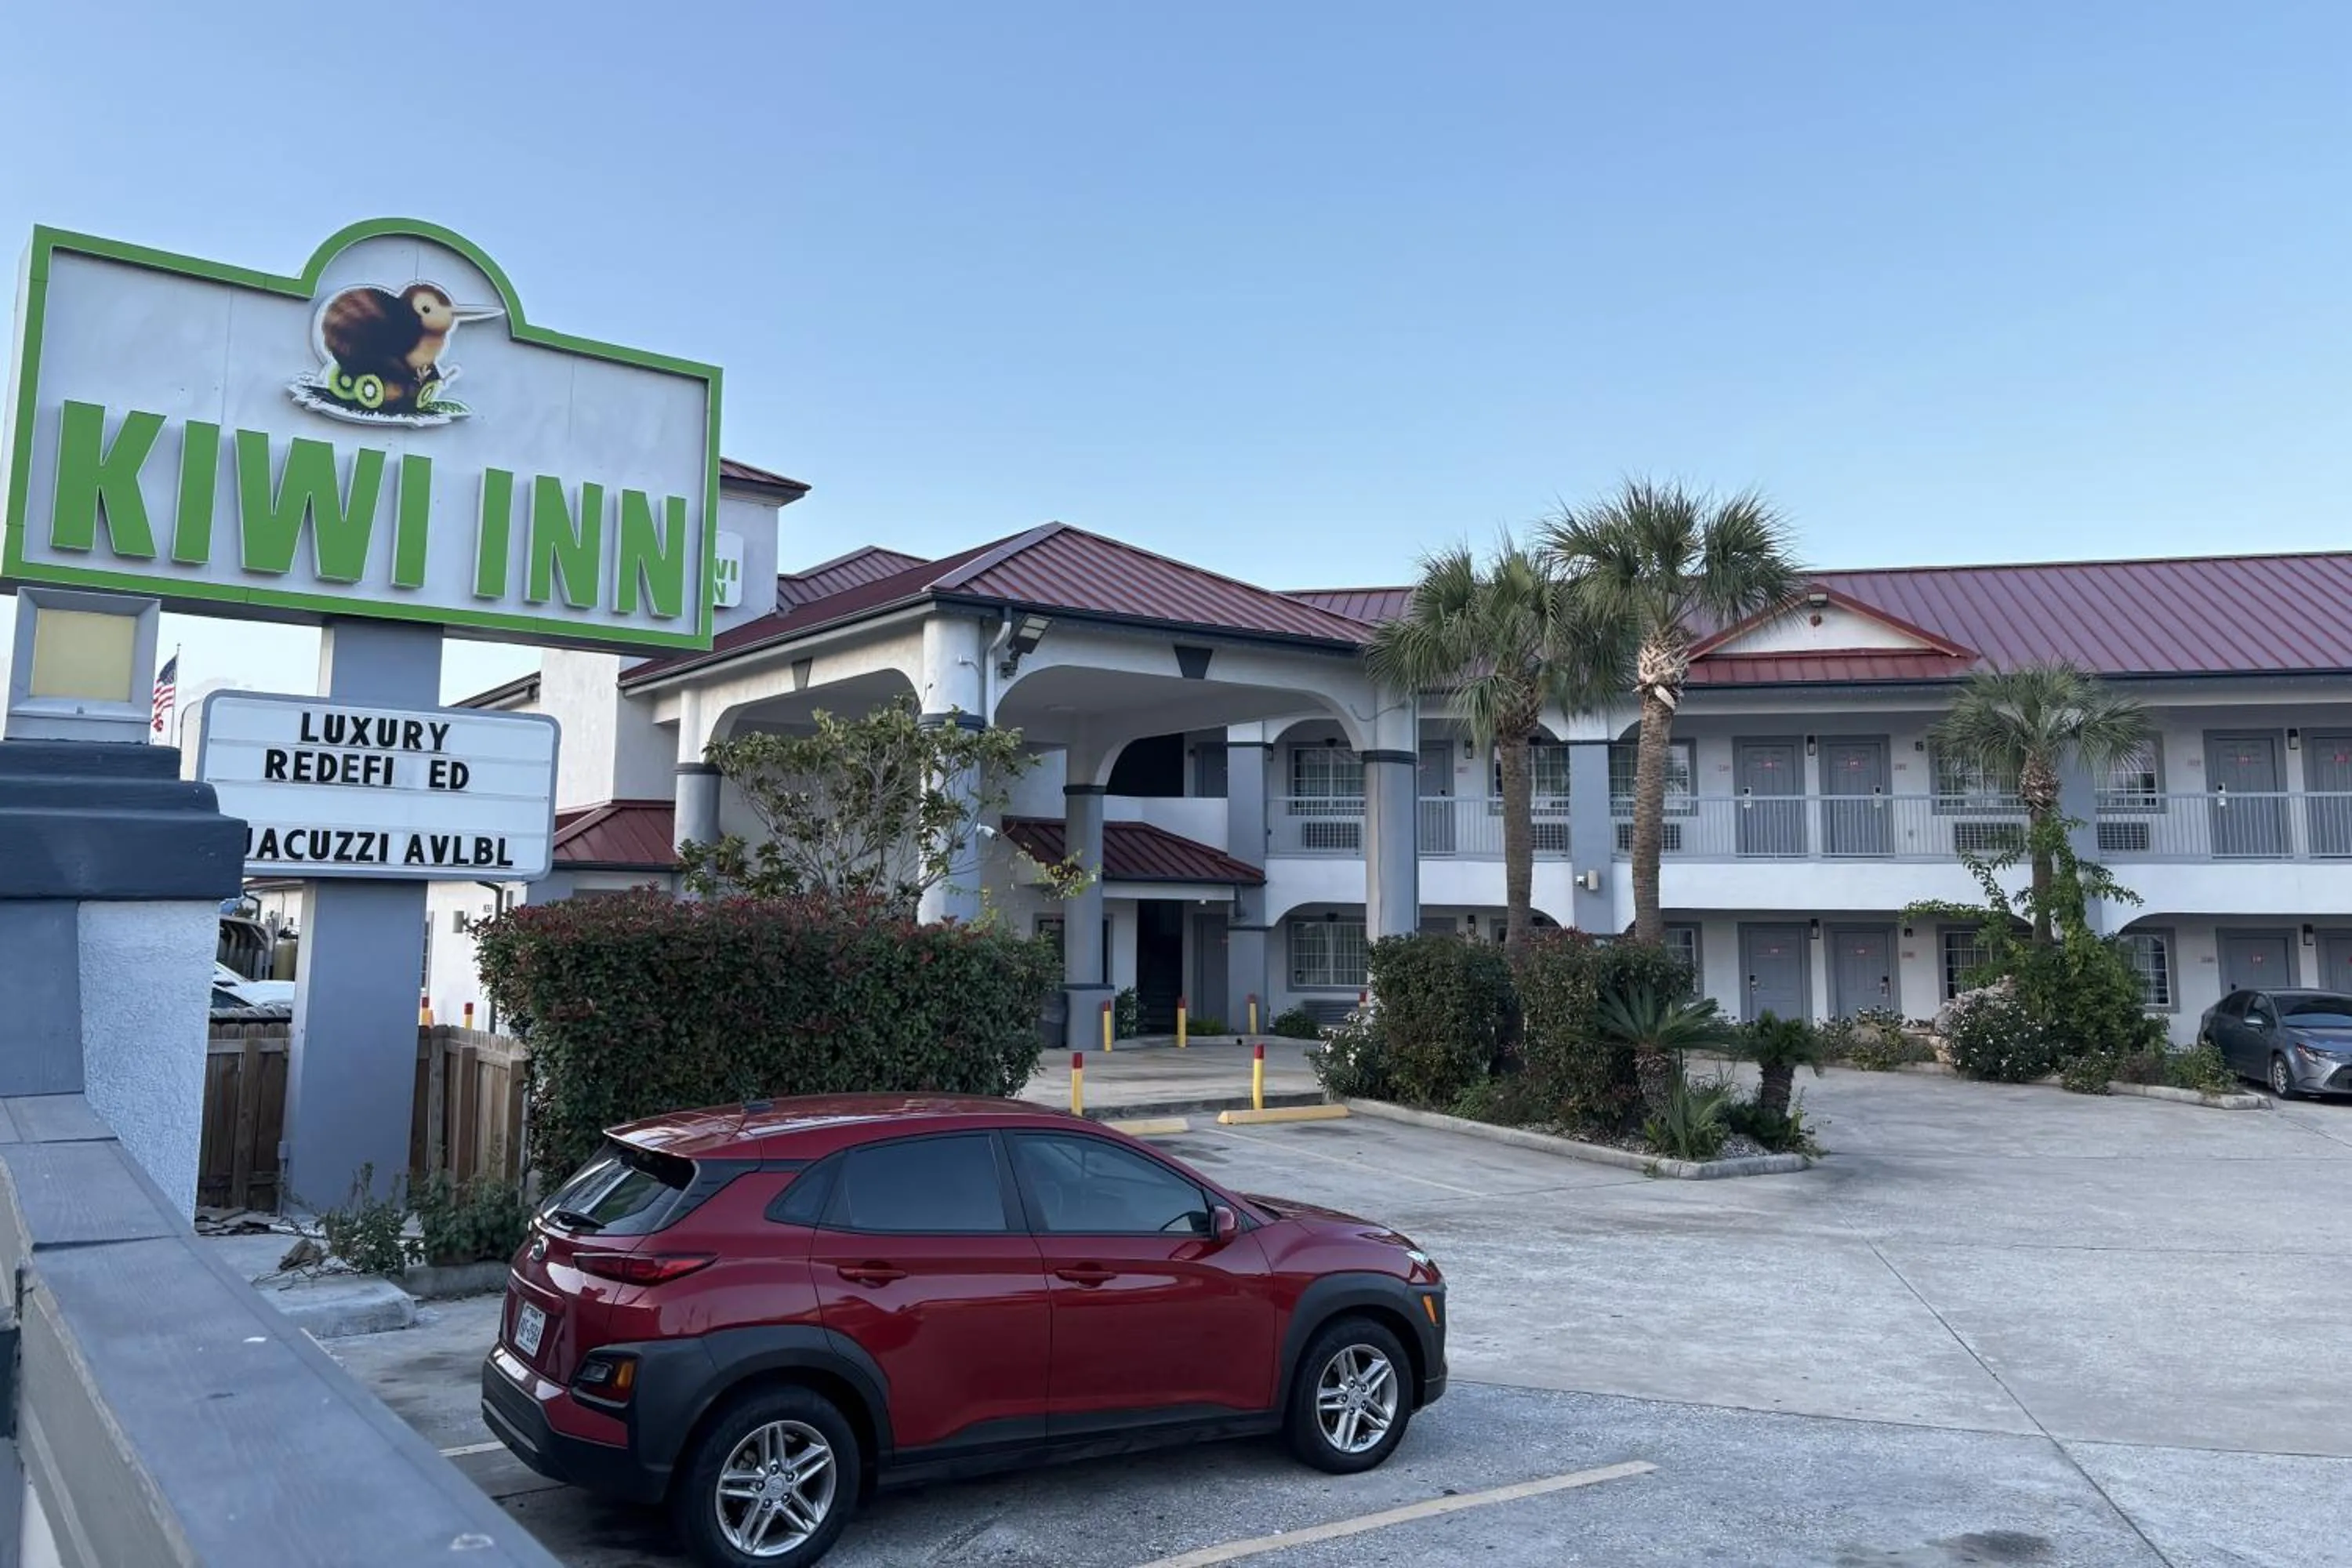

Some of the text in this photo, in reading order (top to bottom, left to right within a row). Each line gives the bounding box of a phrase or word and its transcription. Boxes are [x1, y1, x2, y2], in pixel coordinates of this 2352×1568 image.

[51, 400, 687, 619] KIWI INN
[300, 712, 451, 751] LUXURY
[264, 749, 470, 790] REDEFI ED
[404, 833, 514, 866] AVLBL
